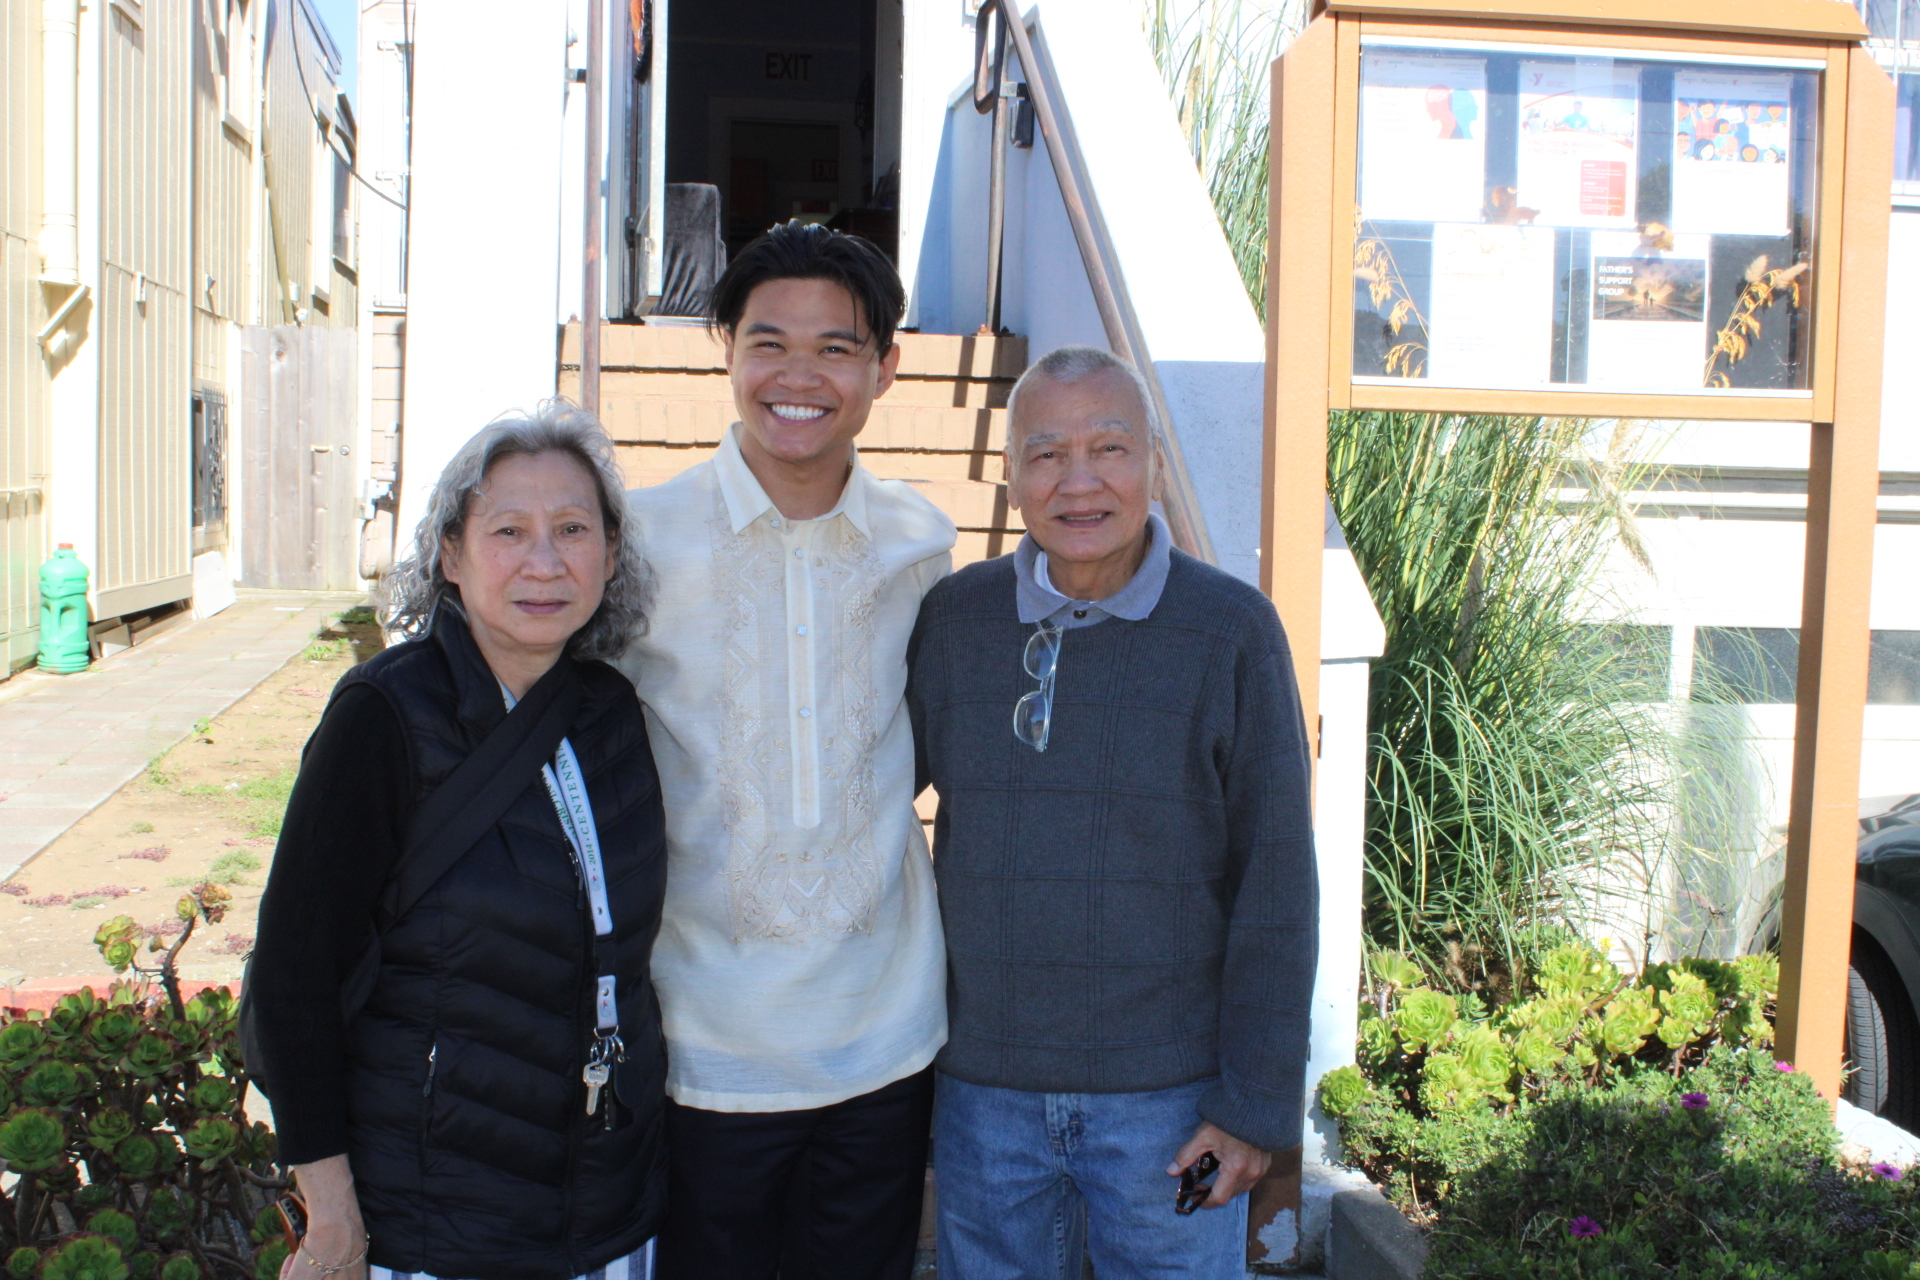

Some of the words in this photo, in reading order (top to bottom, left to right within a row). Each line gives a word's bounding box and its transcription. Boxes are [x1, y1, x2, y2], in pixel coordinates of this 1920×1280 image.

[766, 52, 813, 80] EXIT
[1599, 265, 1633, 274] FATHER'S
[1599, 276, 1633, 285] SUPPORT
[1598, 287, 1625, 296] GROUP
[586, 844, 596, 866] 2014
